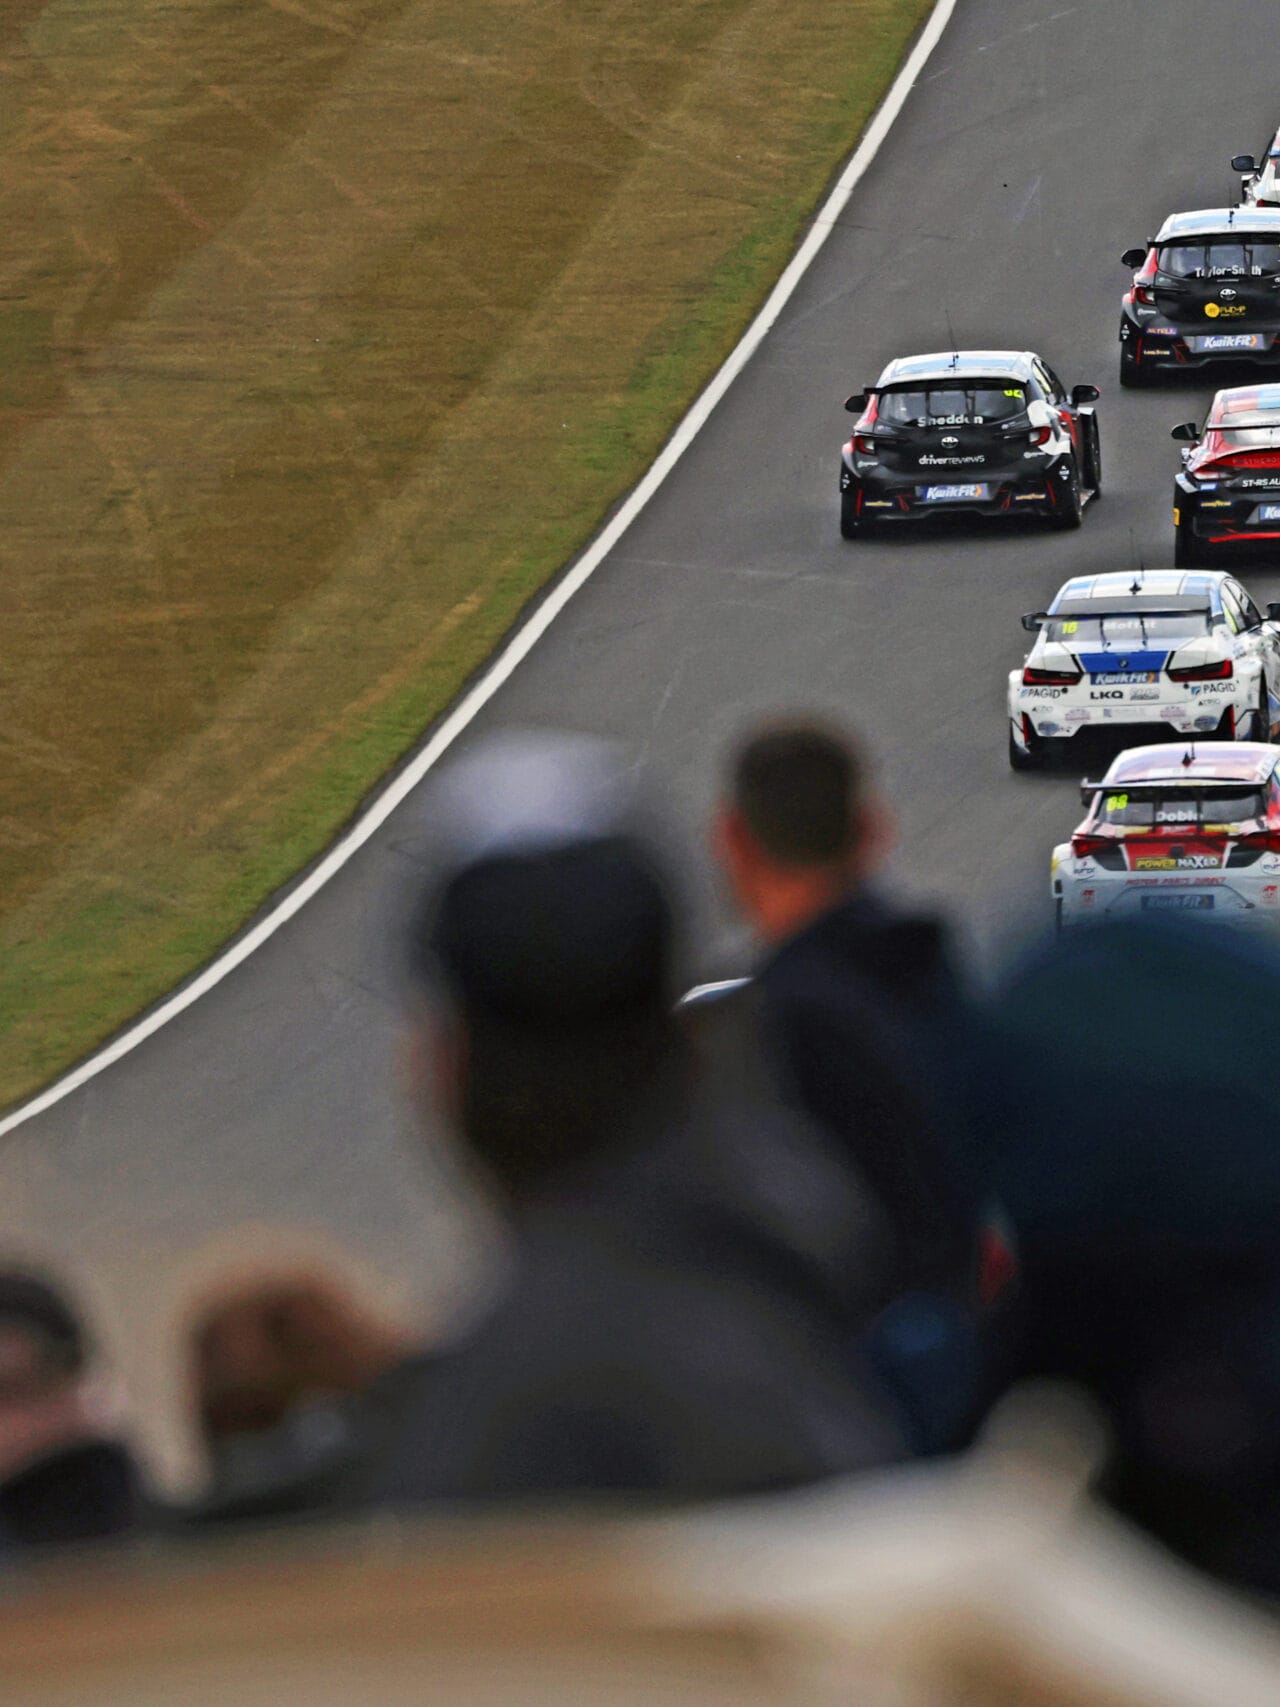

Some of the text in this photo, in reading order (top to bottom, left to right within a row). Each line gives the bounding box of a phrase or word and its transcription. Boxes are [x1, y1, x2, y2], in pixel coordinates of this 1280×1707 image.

[1028, 688, 1061, 698] PAGID
[1203, 683, 1236, 693] PAGID
[1090, 691, 1124, 700] LKQ
[1156, 810, 1204, 822] Dobl
